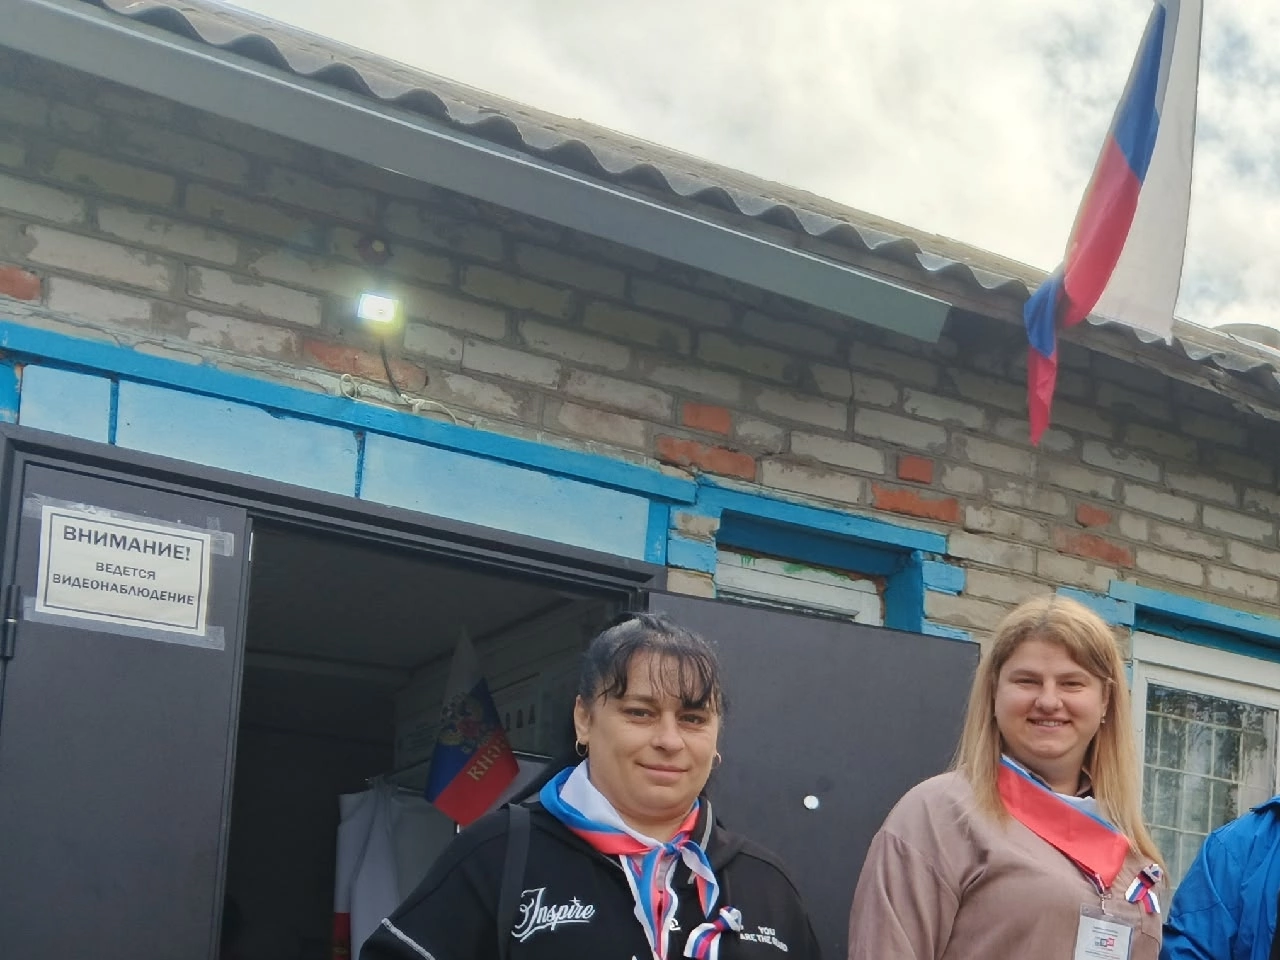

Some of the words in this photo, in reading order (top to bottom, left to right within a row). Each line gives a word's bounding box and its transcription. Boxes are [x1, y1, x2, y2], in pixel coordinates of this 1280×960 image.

[63, 525, 191, 561] ВНИМАНИЕ!
[95, 562, 156, 580] ВЕДЕТСЯ
[52, 573, 195, 605] ВИДЕОНАБЛЮДЕНИЕ
[511, 887, 596, 940] Inspire
